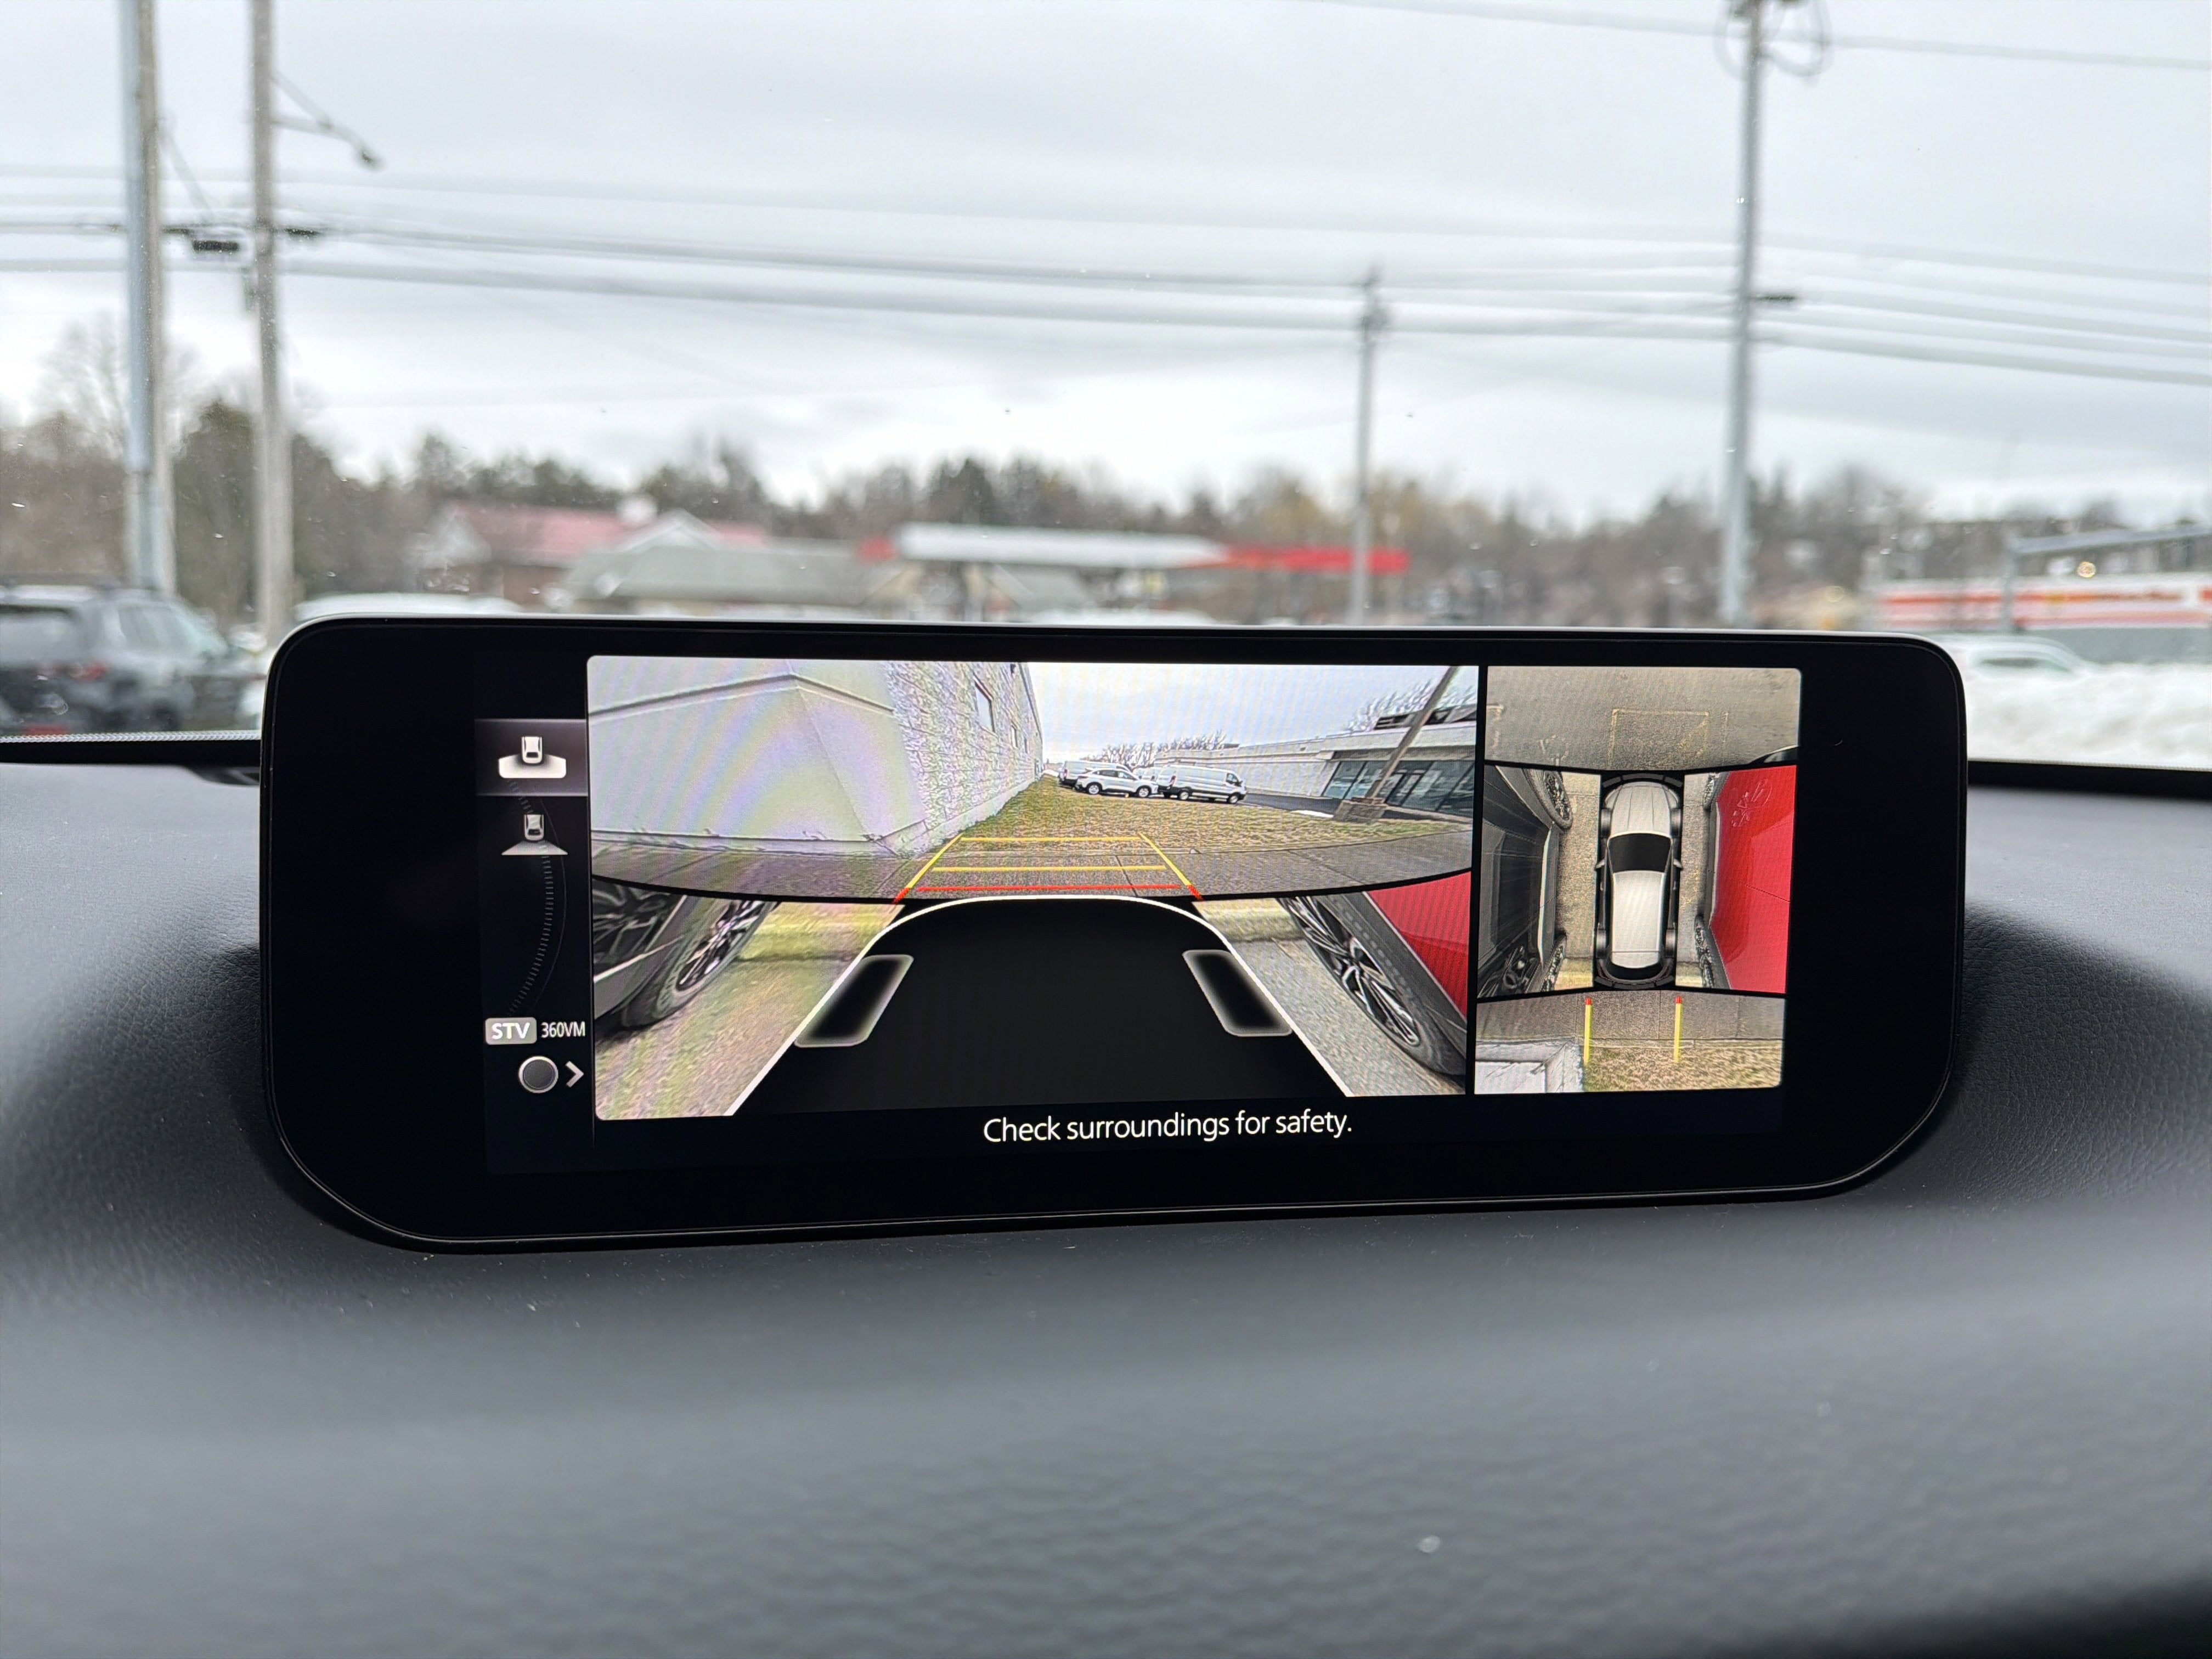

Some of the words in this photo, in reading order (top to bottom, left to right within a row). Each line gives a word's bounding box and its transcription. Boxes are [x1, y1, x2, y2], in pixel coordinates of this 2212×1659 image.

[492, 1022, 531, 1040] STV
[540, 1021, 586, 1039] 360VM
[984, 1115, 1061, 1142] Check
[1066, 1111, 1230, 1142] surroundings
[1234, 1110, 1271, 1135] for
[1276, 1108, 1352, 1138] safety.
